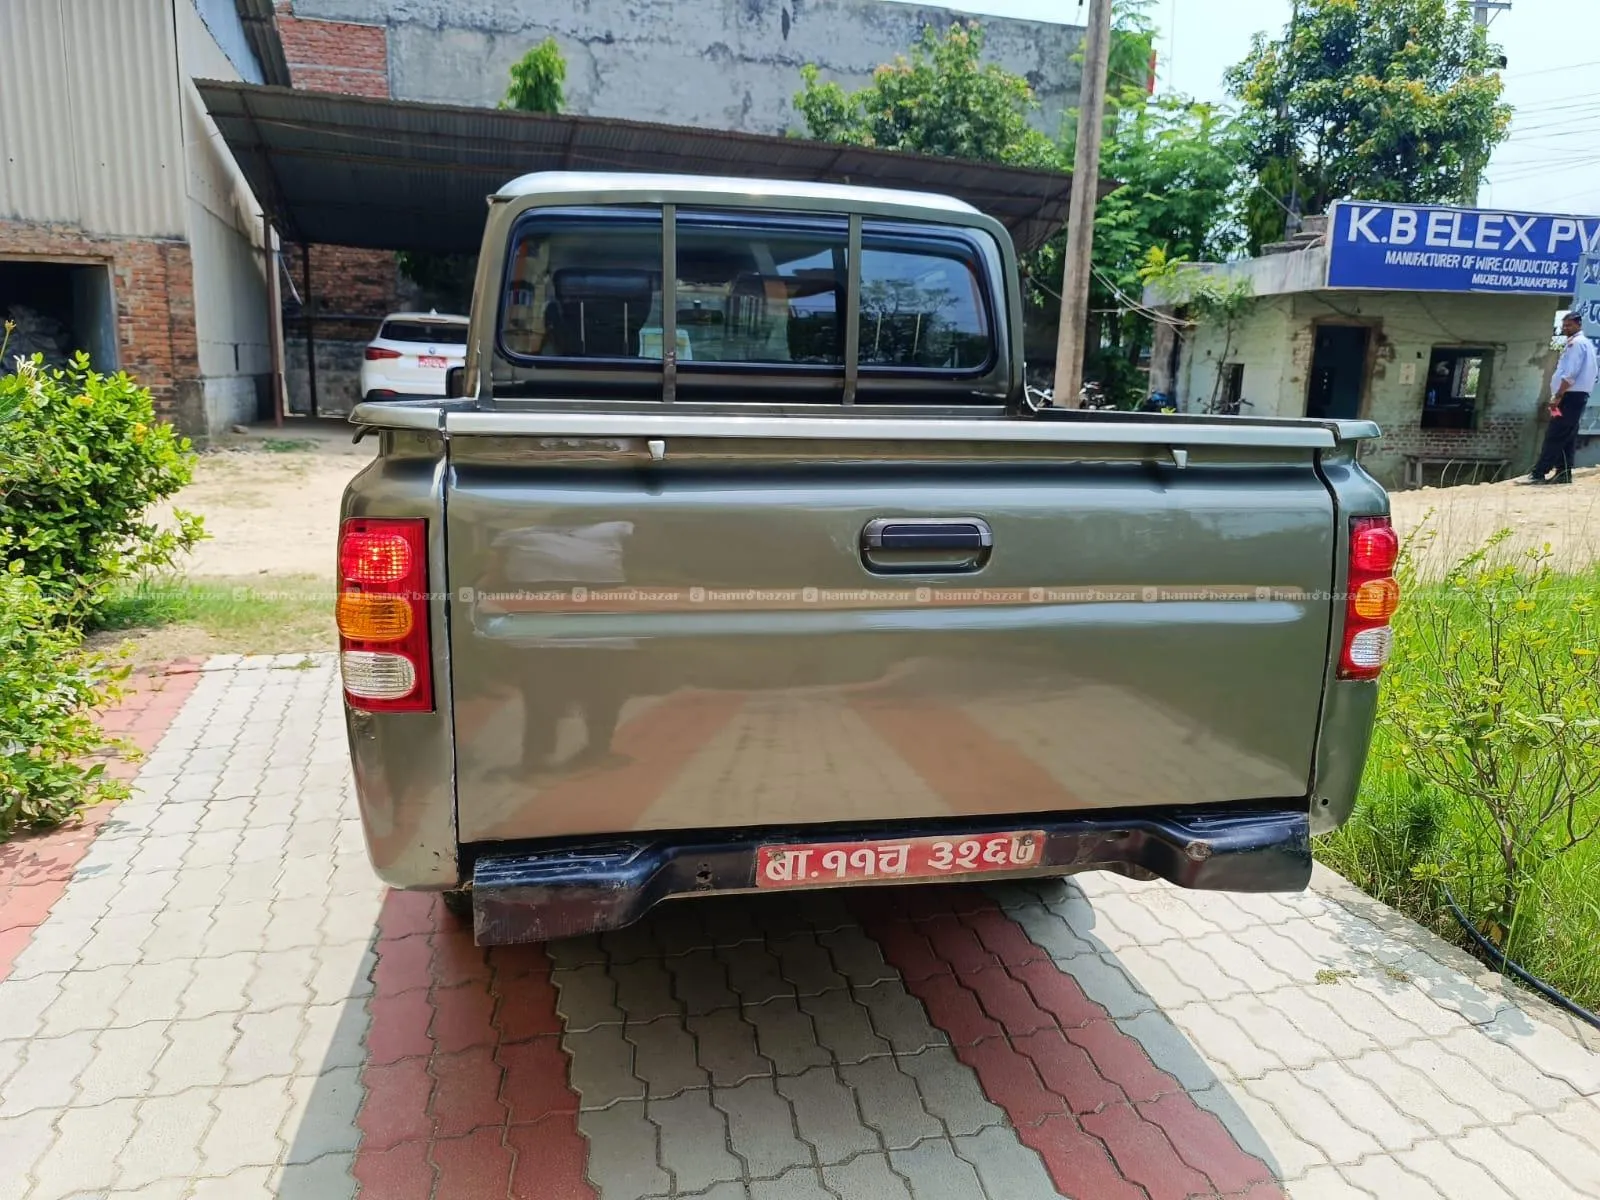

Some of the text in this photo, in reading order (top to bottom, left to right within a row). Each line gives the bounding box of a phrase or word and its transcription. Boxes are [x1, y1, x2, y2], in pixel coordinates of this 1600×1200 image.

[1347, 206, 1418, 245] K.B
[1425, 211, 1538, 253] ELEX
[1385, 251, 1460, 268] MANUFACTURER
[1462, 255, 1475, 269] OF
[1560, 262, 1569, 275] &
